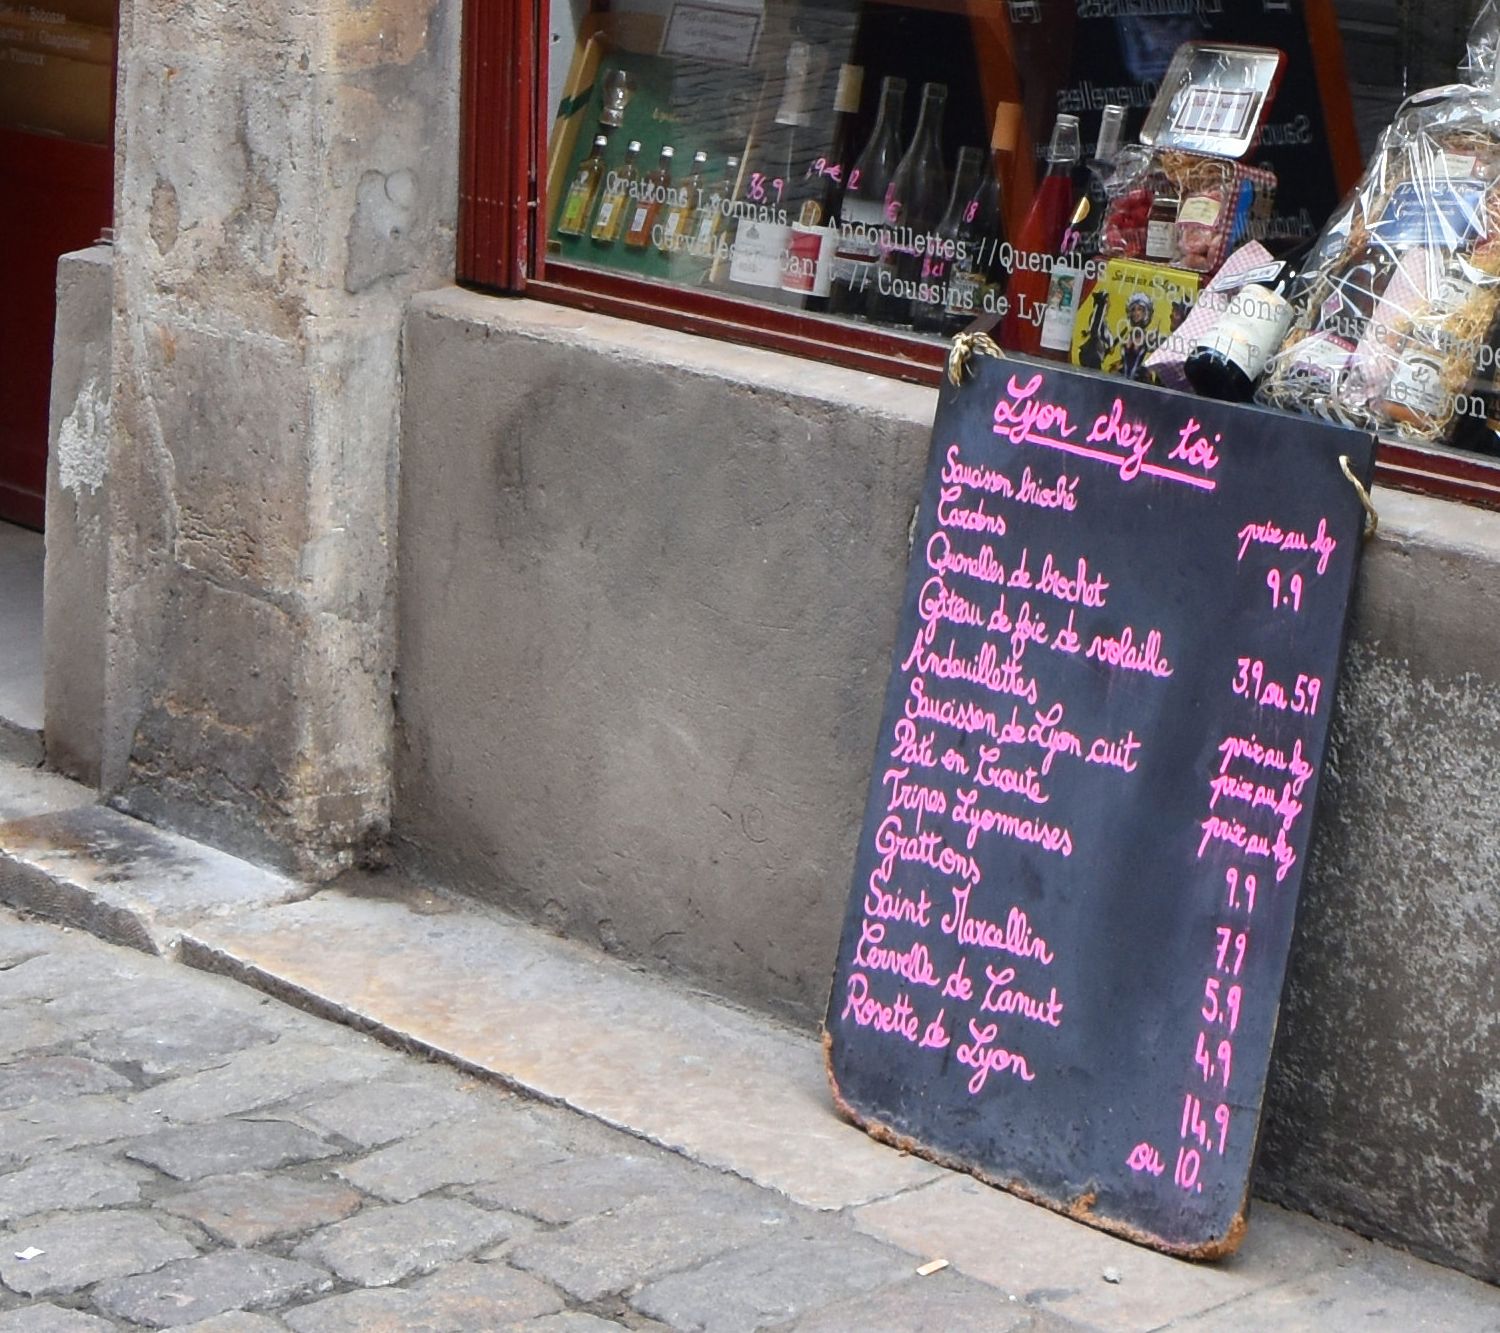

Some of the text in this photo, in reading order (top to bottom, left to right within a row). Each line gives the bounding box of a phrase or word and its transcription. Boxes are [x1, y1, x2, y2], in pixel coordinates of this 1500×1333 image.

[606, 171, 689, 208] Grattons
[695, 189, 788, 226] Lyonnais
[826, 215, 968, 261] Andouillettes
[999, 241, 1108, 280] Quenelles
[878, 263, 974, 311] Coussins
[983, 287, 1010, 316] de
[993, 373, 1222, 480] Lyon chez toi
[941, 444, 1080, 513] Saucisson brioché
[937, 487, 1007, 536] Cardons
[1237, 518, 1337, 575] prix au kg
[1006, 554, 1034, 591] de
[1035, 557, 1110, 609] brochet
[1265, 568, 1303, 613] 9.9
[918, 576, 1175, 680] Gâteau de foie de volaille
[901, 632, 1040, 705] Andouillettes
[1261, 684, 1290, 712] ou
[904, 683, 1140, 774] Saucisson de Lyon cuit
[940, 746, 970, 777] en
[1259, 745, 1288, 773] au
[883, 769, 1074, 858] Tripes Lyonnaises
[1209, 772, 1254, 810] prix
[1250, 782, 1279, 809] au
[875, 815, 981, 885] Grattons
[1197, 815, 1246, 858] prix
[1243, 831, 1271, 856] au
[864, 869, 1055, 966] Saint Marcellin
[1225, 867, 1258, 914] 9.9
[853, 920, 1064, 1028] Cervelle de Canut
[1216, 926, 1248, 975] 7.9
[1201, 979, 1243, 1033] 5.9
[841, 973, 1036, 1095] Rosette de Lyon
[1194, 1033, 1233, 1087] 4.9
[1181, 1094, 1231, 1154] 14.9
[1126, 1143, 1165, 1177] ou
